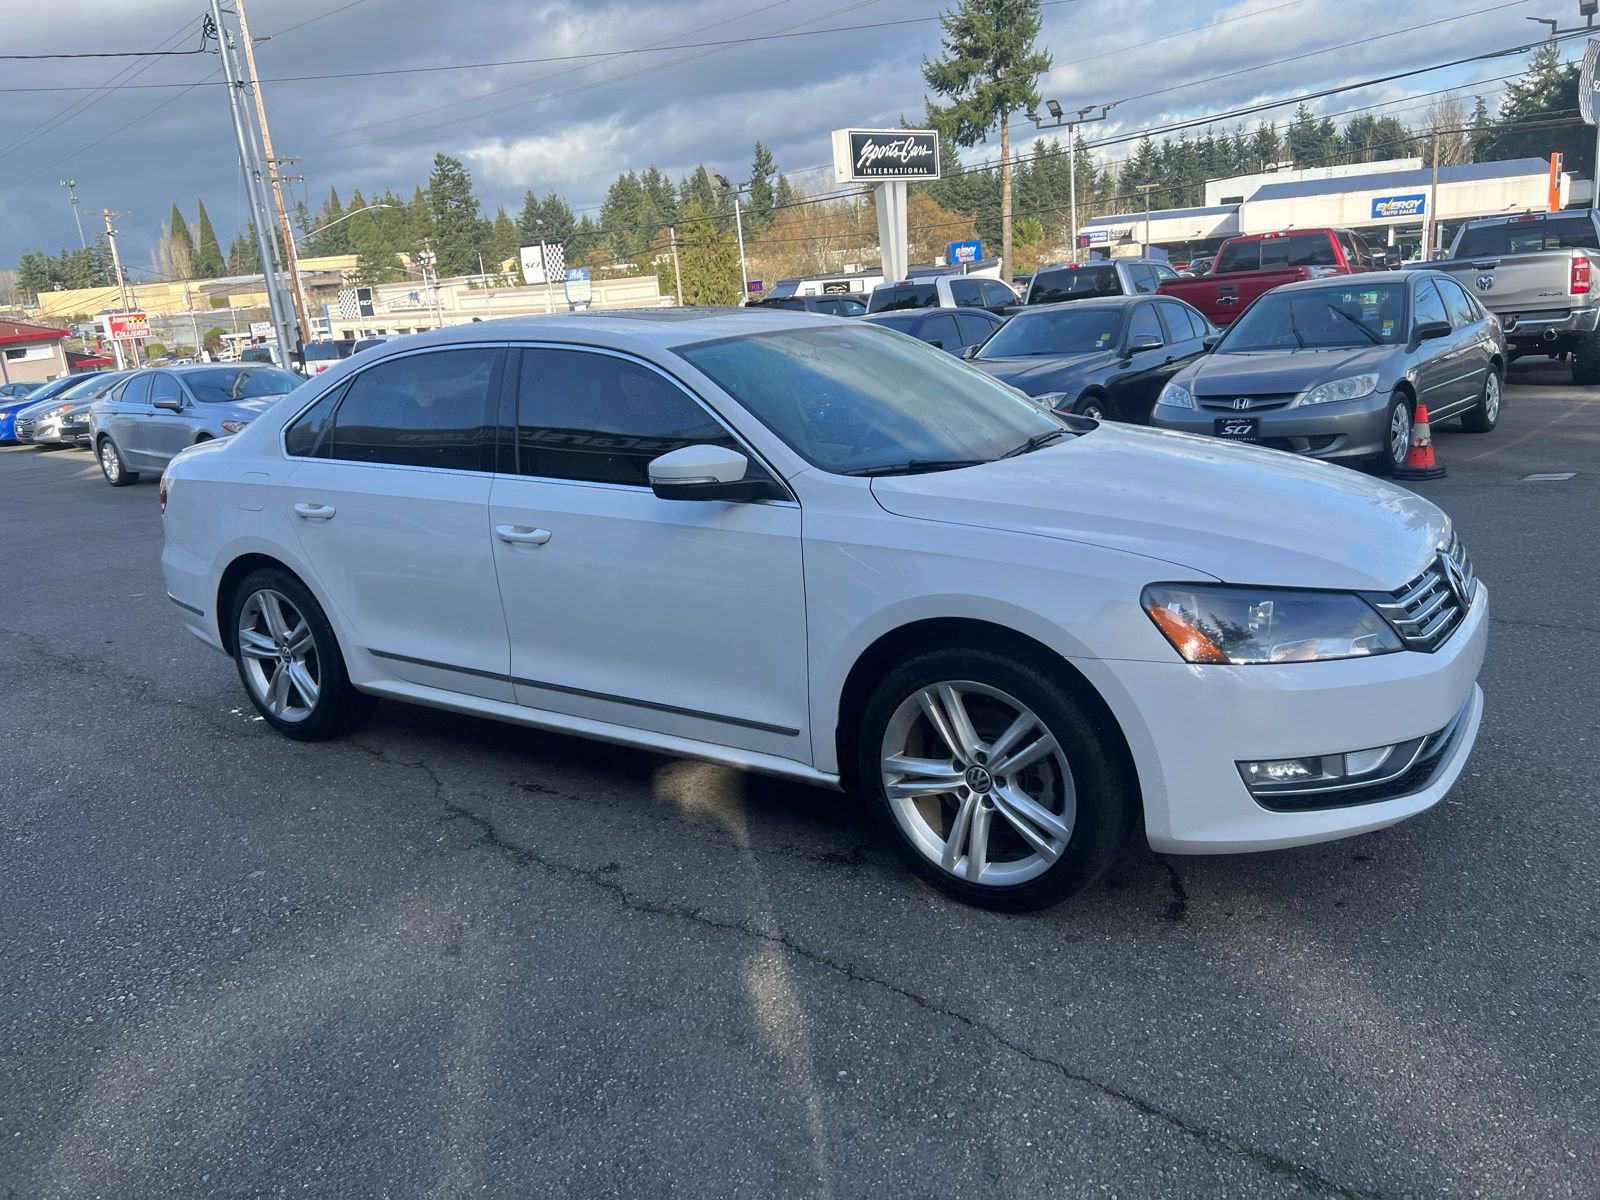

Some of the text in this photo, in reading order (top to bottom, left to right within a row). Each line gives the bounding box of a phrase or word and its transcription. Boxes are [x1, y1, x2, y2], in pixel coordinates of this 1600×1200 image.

[857, 137, 932, 168] Sports Cars
[525, 261, 541, 269] SCI
[114, 329, 148, 338] COLLISION
[1221, 425, 1252, 434] SCI
